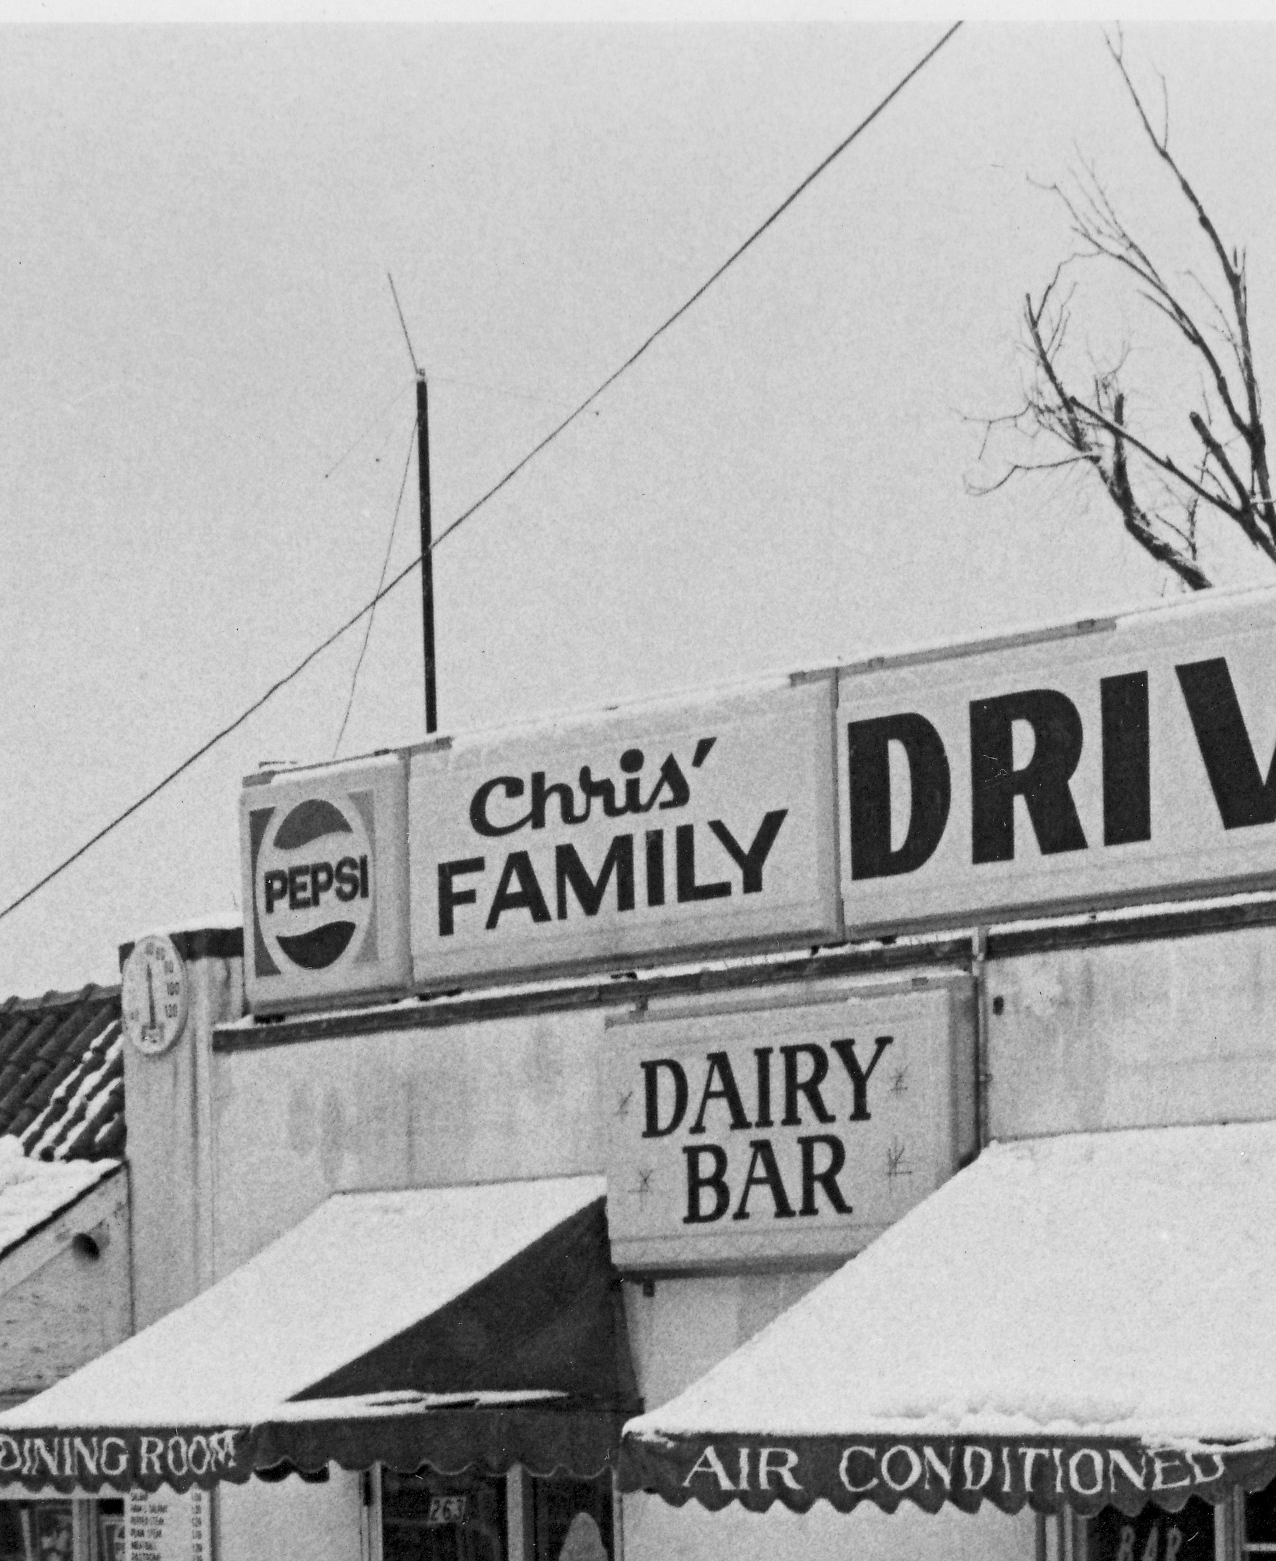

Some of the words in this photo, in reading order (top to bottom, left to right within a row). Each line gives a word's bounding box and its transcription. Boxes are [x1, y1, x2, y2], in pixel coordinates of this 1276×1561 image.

[468, 737, 718, 837] Chris'
[263, 855, 370, 915] PEPSI
[436, 808, 789, 937] FAMILY
[640, 1036, 894, 1141] DAIRY
[682, 1133, 853, 1225] BAR
[140, 1430, 240, 1476] ROOM
[682, 1445, 804, 1491] AIR
[838, 1445, 1226, 1495] CONDITIONED
